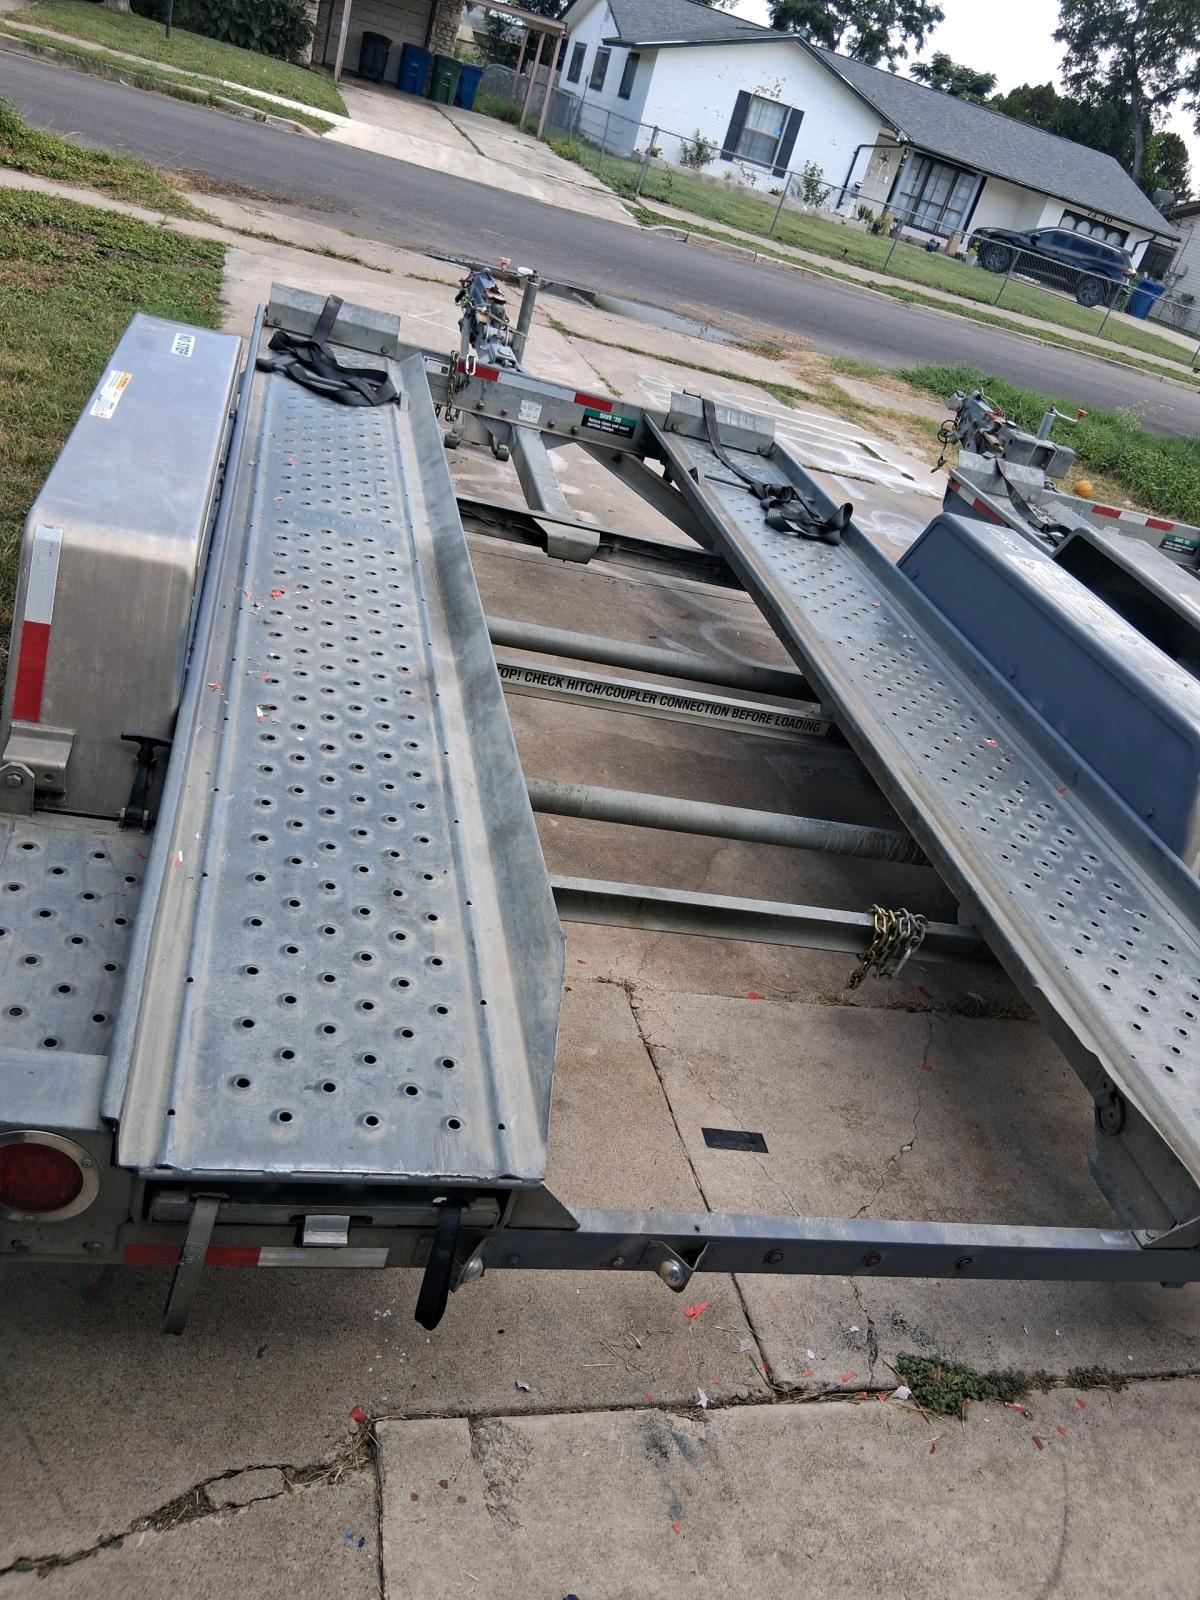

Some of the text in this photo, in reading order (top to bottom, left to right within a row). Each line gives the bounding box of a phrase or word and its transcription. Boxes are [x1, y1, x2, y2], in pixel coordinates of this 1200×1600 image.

[524, 671, 564, 688] CHECK
[566, 678, 658, 704] HITCH/COUPLER
[659, 695, 730, 717] CONNECTION
[731, 708, 773, 725] BEFORE
[774, 715, 821, 732] LOADING
